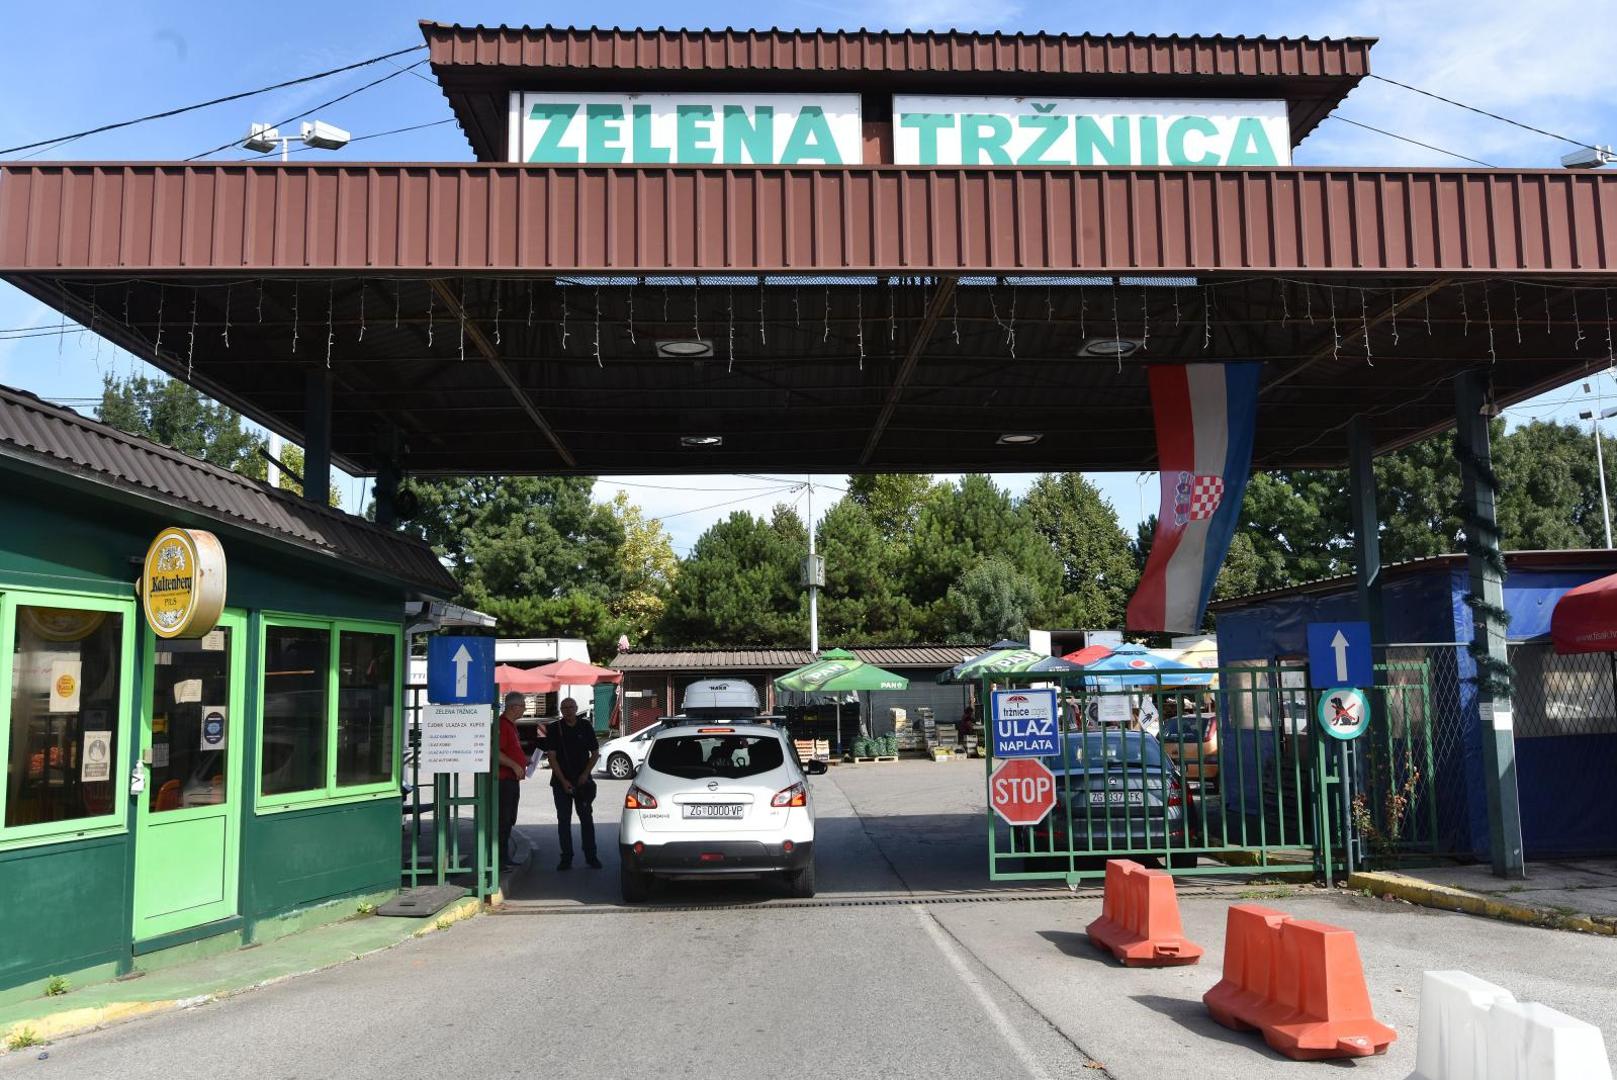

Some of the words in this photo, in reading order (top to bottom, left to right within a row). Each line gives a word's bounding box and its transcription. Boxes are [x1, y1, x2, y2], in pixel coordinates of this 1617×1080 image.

[528, 103, 844, 164] ZELENA
[900, 103, 1279, 166] TRŽNICA
[151, 575, 192, 593] Kaltenberg
[164, 598, 177, 607] PILS
[880, 681, 897, 689] PAN
[1003, 707, 1030, 717] tržnice
[998, 719, 1053, 738] ULAZ
[1000, 739, 1053, 752] NAPLATA
[995, 777, 1050, 804] STOP
[690, 805, 702, 816] ZG
